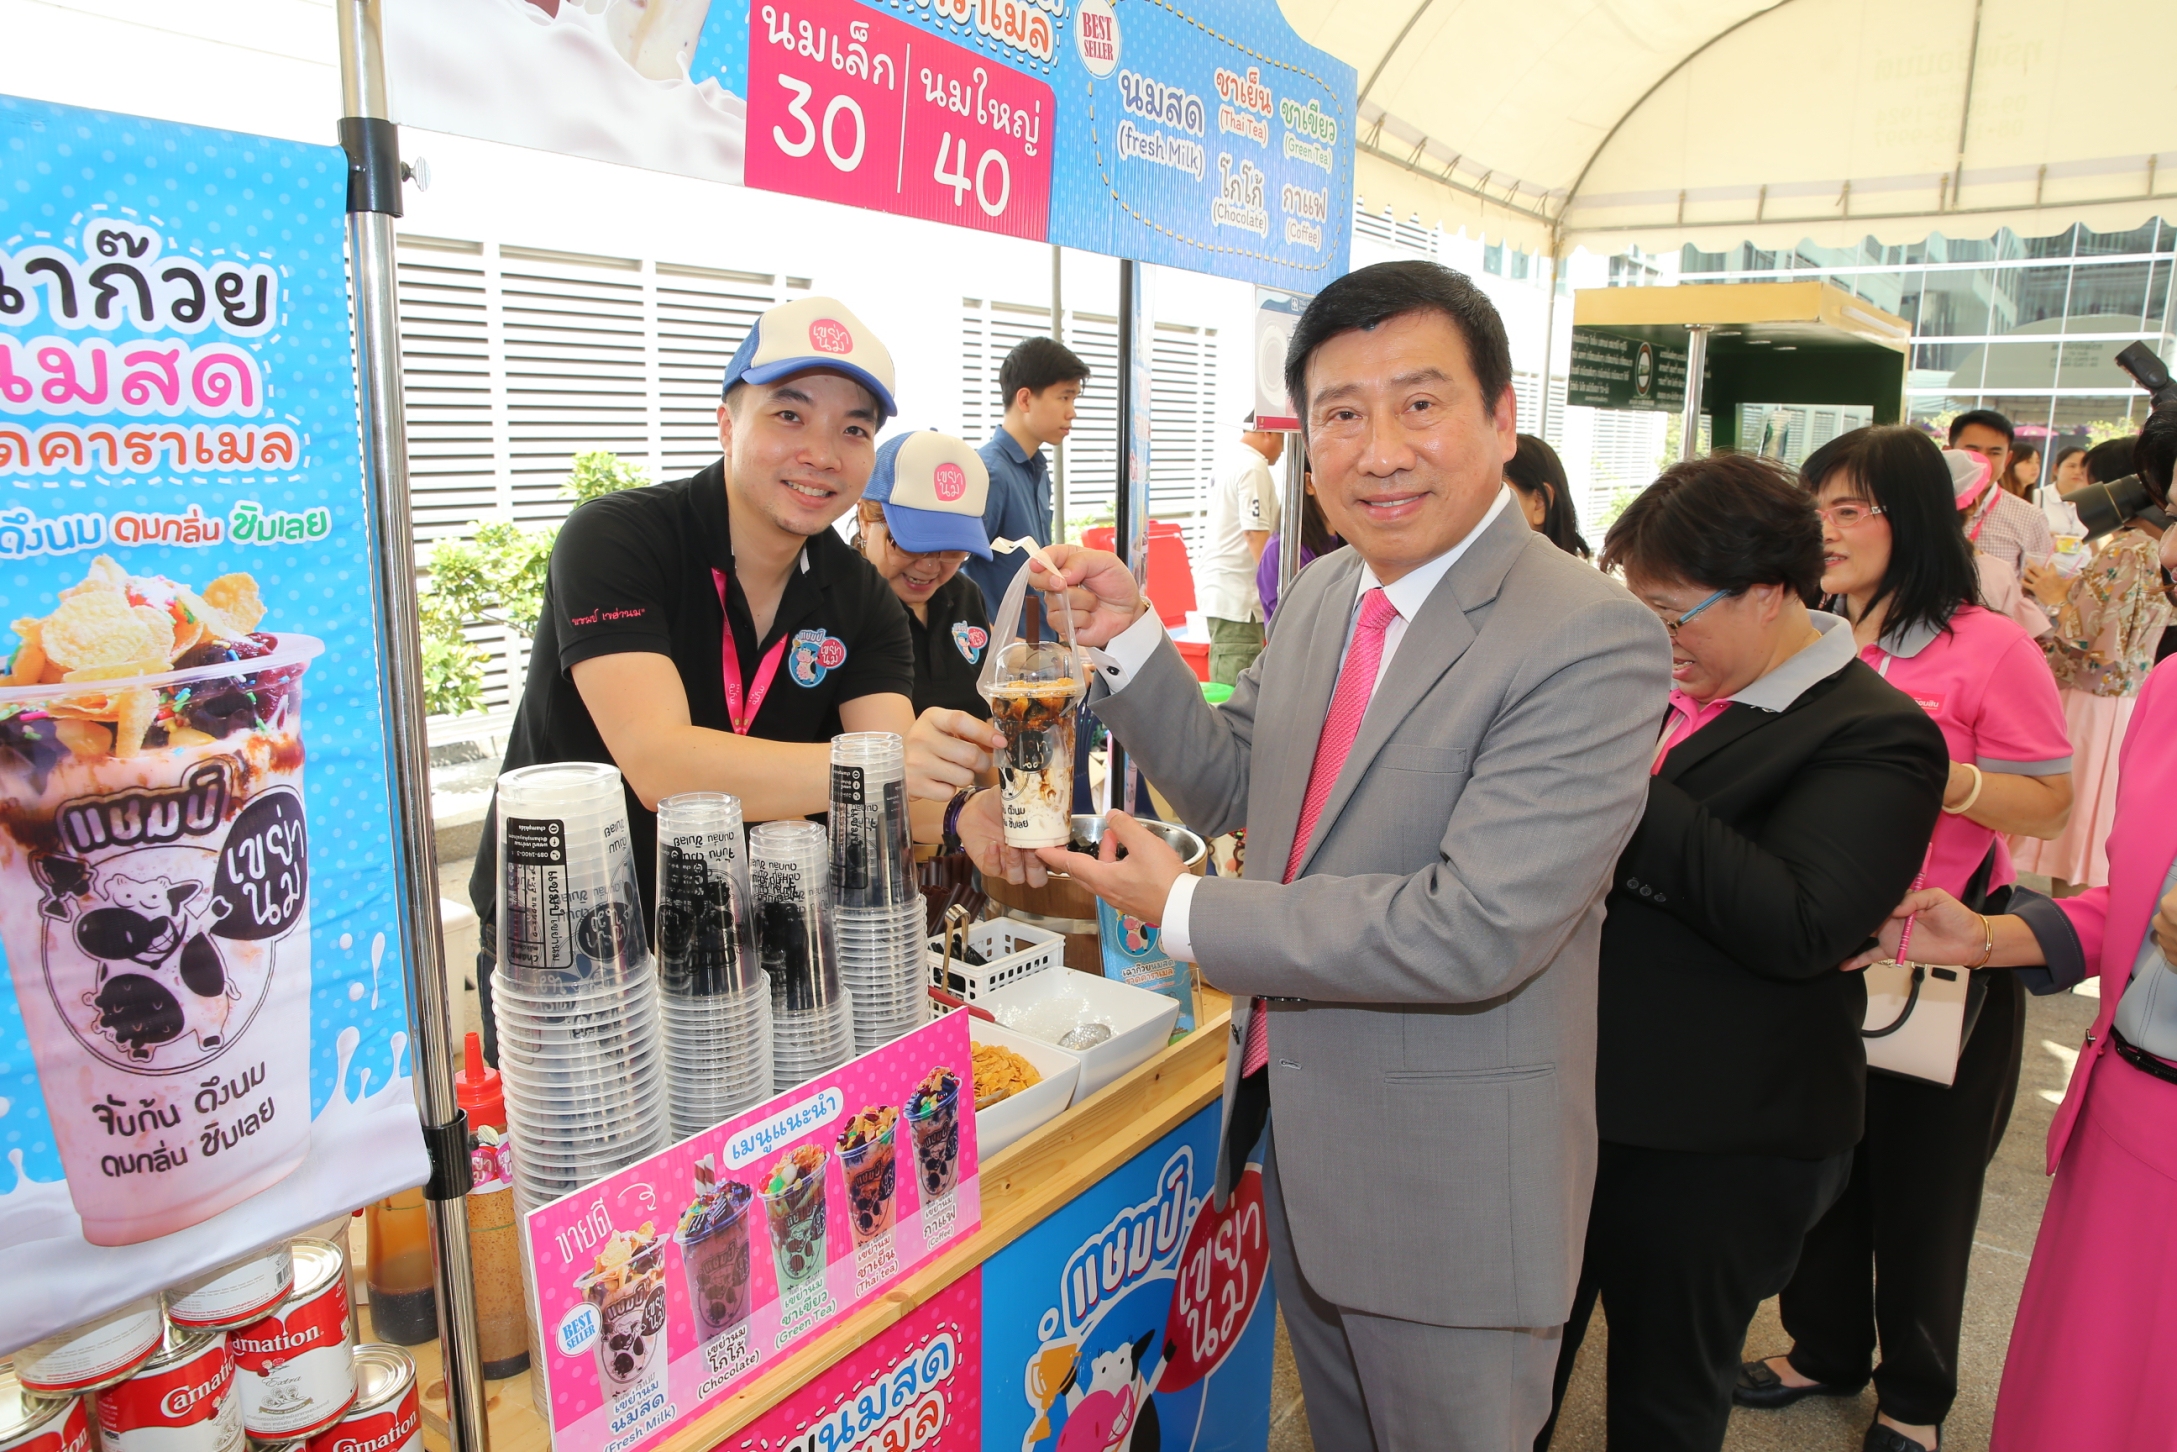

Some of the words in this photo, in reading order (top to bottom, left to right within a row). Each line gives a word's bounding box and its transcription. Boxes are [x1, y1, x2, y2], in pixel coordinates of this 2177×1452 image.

[1082, 11, 1112, 42] BEST
[761, 5, 895, 91] นมเล็ก
[1084, 39, 1114, 61] SELLER
[920, 66, 1040, 156] นมใหญ่
[1121, 74, 1202, 133] นมสด
[1216, 70, 1273, 115] ชาเย็น
[773, 73, 866, 172] 30
[1219, 108, 1245, 133] (Thai
[1246, 116, 1269, 145] Tea)
[1281, 100, 1336, 142] ชาเขียว
[1118, 124, 1165, 157] (fresh
[1168, 138, 1204, 178] Milk)
[1283, 134, 1314, 160] (Green
[1314, 145, 1333, 171] Tea)
[933, 131, 1010, 217] 40
[1219, 156, 1263, 208] โกโก้
[1212, 200, 1268, 235] (Chocolate)
[1283, 185, 1328, 221] กาแฟ
[1286, 222, 1322, 250] (Coffee)
[813, 323, 849, 345] เขย่า
[816, 336, 845, 353] นม
[1252, 499, 1260, 518] 3
[0, 512, 101, 554] ดึงนม
[114, 508, 220, 544] ดมกลิ่น
[232, 505, 328, 542] ชิมเลย
[194, 1061, 266, 1114] ดึงนม
[731, 1095, 837, 1161] เมนูแนะนำ
[100, 1140, 189, 1178] ดมกลิ่น
[554, 1197, 615, 1264] ขายดี
[923, 1208, 957, 1239] กาแฟ
[927, 1226, 955, 1250] (Coffee)
[855, 1272, 880, 1298] (Thai
[881, 1260, 900, 1280] tea)
[856, 1247, 897, 1280] ชาเย็น
[781, 1290, 829, 1326] ชาเขียว
[784, 1277, 824, 1308] เขย่านม
[562, 1308, 592, 1341] BEST
[566, 1324, 596, 1351] SELLER
[706, 1325, 747, 1358] เขย่านม
[774, 1317, 812, 1350] (Green
[813, 1299, 837, 1322] Tea)
[697, 1349, 761, 1399] (Chocolate)
[708, 1340, 747, 1373] โกโก้
[160, 1352, 235, 1419] Carnatio
[613, 1380, 660, 1414] เขย่านม
[611, 1392, 665, 1434] นมสด
[645, 1403, 678, 1439] Milk)
